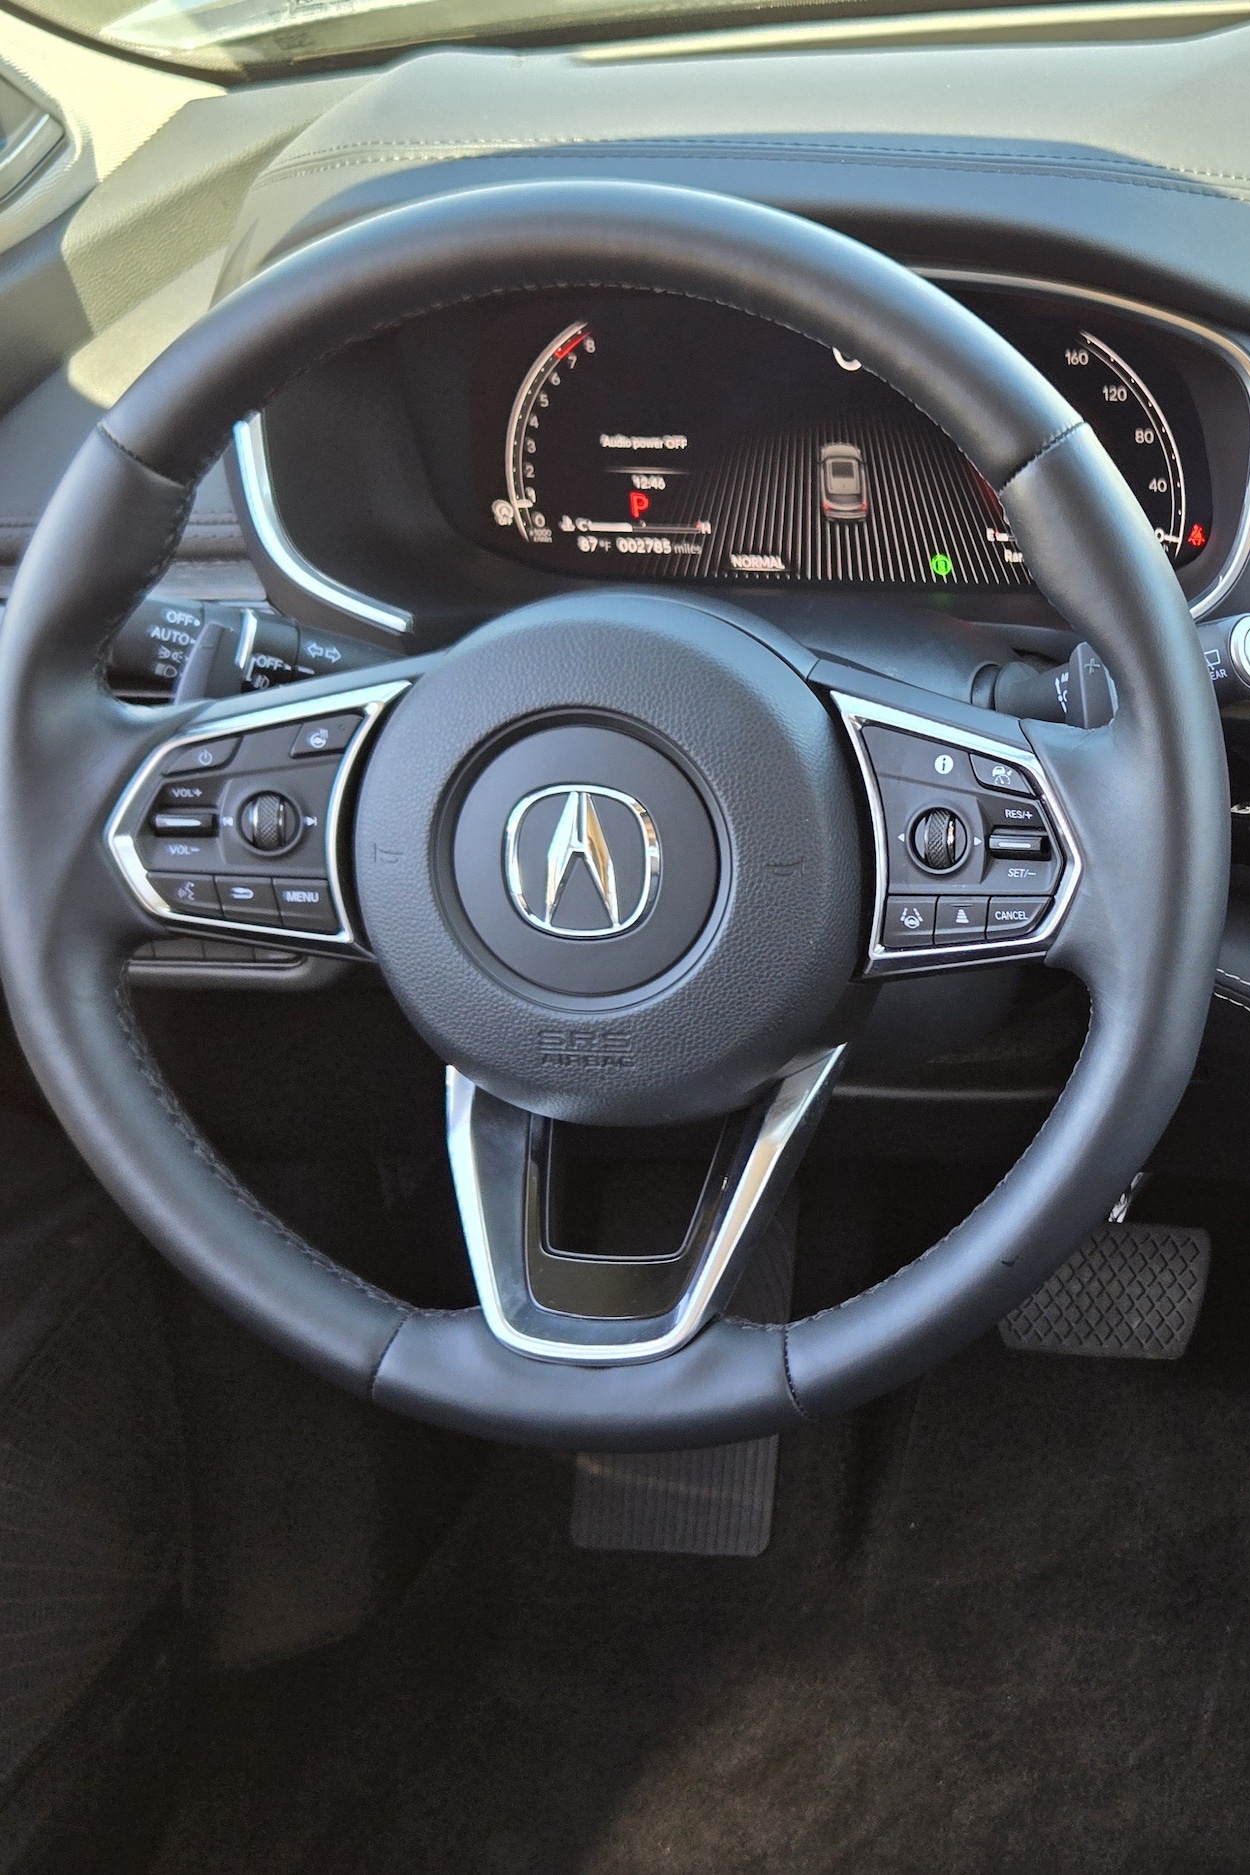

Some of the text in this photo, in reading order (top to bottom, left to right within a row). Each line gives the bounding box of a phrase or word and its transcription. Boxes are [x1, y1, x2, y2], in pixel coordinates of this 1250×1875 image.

[583, 337, 596, 353] 8
[567, 355, 577, 369] 7
[1064, 350, 1089, 366] 160
[551, 372, 561, 386] 6
[539, 394, 549, 407] 5
[1102, 386, 1128, 402] 120
[529, 414, 539, 429] 4
[601, 434, 688, 451] Audio power OFF
[1134, 428, 1154, 444] 80
[526, 439, 536, 453] 3
[525, 465, 535, 479] 2
[1149, 477, 1167, 493] 40
[527, 487, 536, 503] 1
[630, 492, 650, 519] P
[532, 511, 545, 527] 0
[986, 528, 995, 542] E
[577, 536, 598, 552] 87
[616, 537, 672, 554] 002785
[673, 541, 702, 555] miles
[731, 553, 785, 570] NORMAL
[1004, 549, 1024, 562] Ran
[166, 611, 192, 626] OFF
[151, 626, 190, 645] AUTO
[256, 655, 283, 670] OFF
[1209, 669, 1228, 680] EAR
[1005, 809, 1033, 820] RES/+
[285, 891, 319, 903] MENU
[995, 911, 1028, 920] CANCEL
[538, 1030, 632, 1051] SRS
